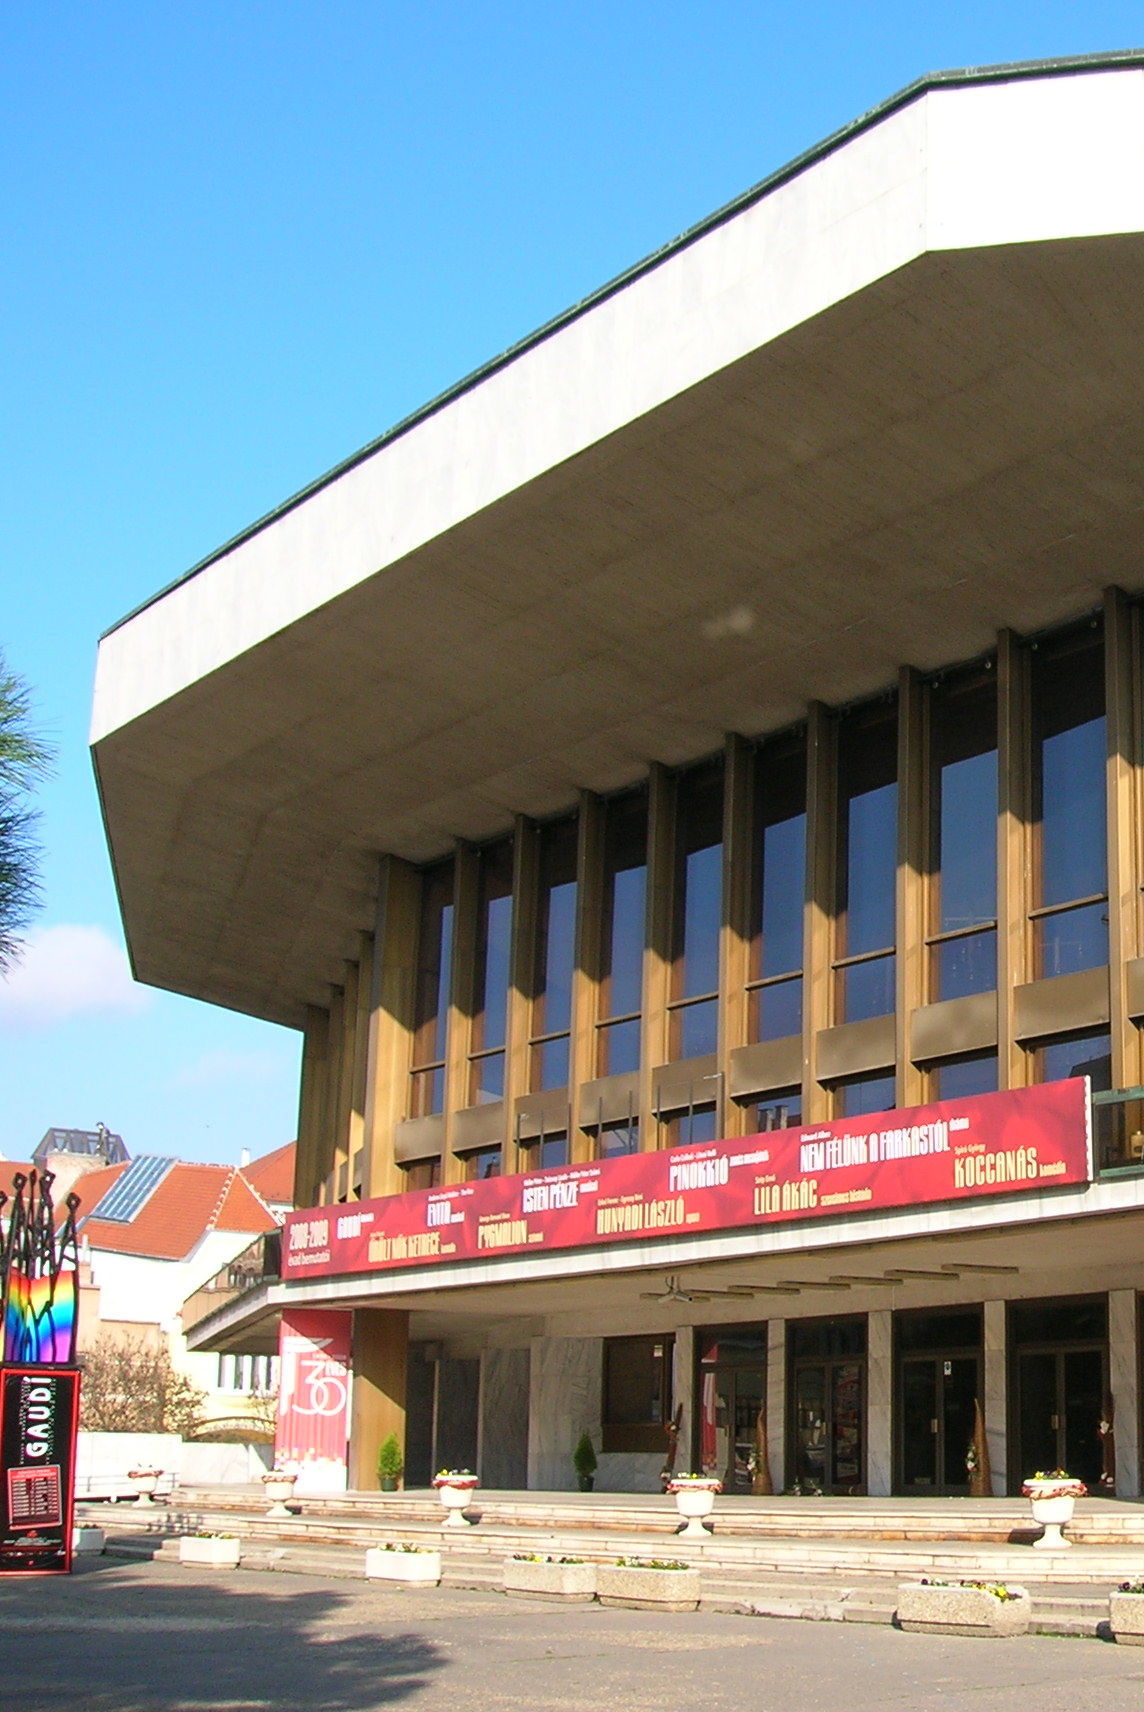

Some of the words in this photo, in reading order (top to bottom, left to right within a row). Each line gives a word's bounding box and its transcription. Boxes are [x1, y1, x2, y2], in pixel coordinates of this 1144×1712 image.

[800, 1142, 824, 1173] NEM
[869, 1132, 879, 1163] A
[880, 1119, 951, 1161] FARKASTÓL
[954, 1145, 1037, 1188] KOCCANÁS
[670, 1154, 728, 1192] PINOKKIÓ
[597, 1203, 643, 1235] HUNYADI
[644, 1195, 684, 1229] LÁSZLÓ
[754, 1184, 780, 1215] LILA
[782, 1178, 818, 1211] ÁKÁC
[292, 1360, 346, 1416] 30
